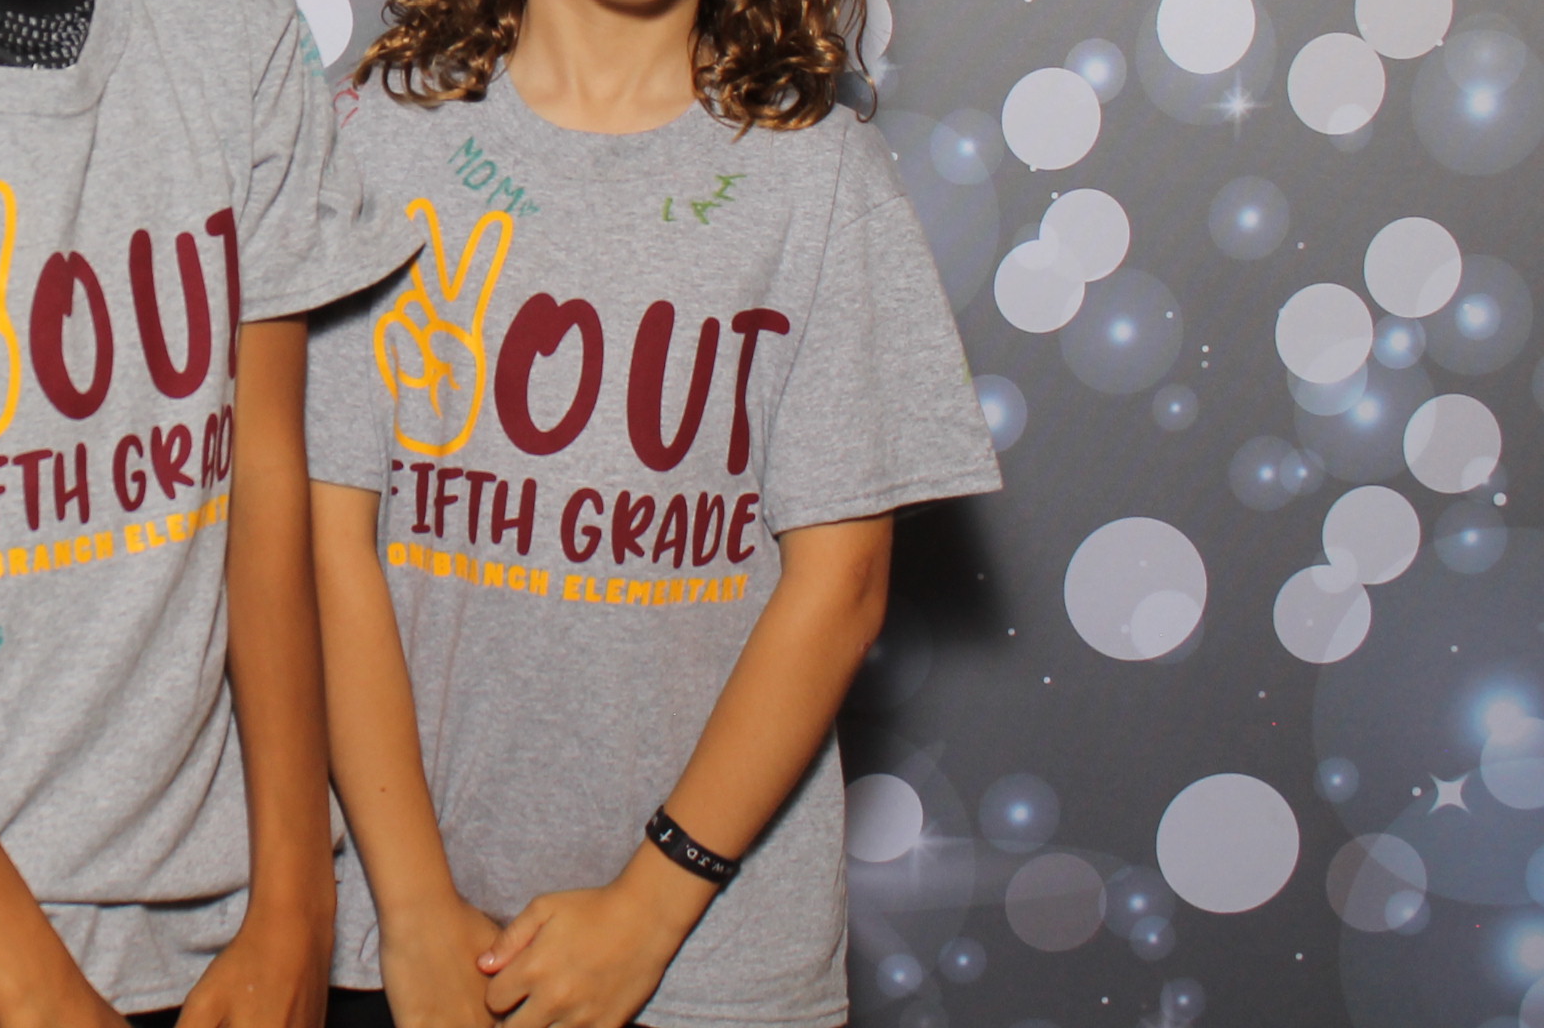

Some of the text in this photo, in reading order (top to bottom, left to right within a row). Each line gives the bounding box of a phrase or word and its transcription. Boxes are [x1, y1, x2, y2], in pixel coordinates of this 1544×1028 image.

[29, 207, 241, 420] OUT
[494, 292, 790, 475] OUT
[112, 403, 234, 513] GRAD
[560, 487, 760, 569] GRADE
[562, 574, 749, 606] ELEMENTARY
